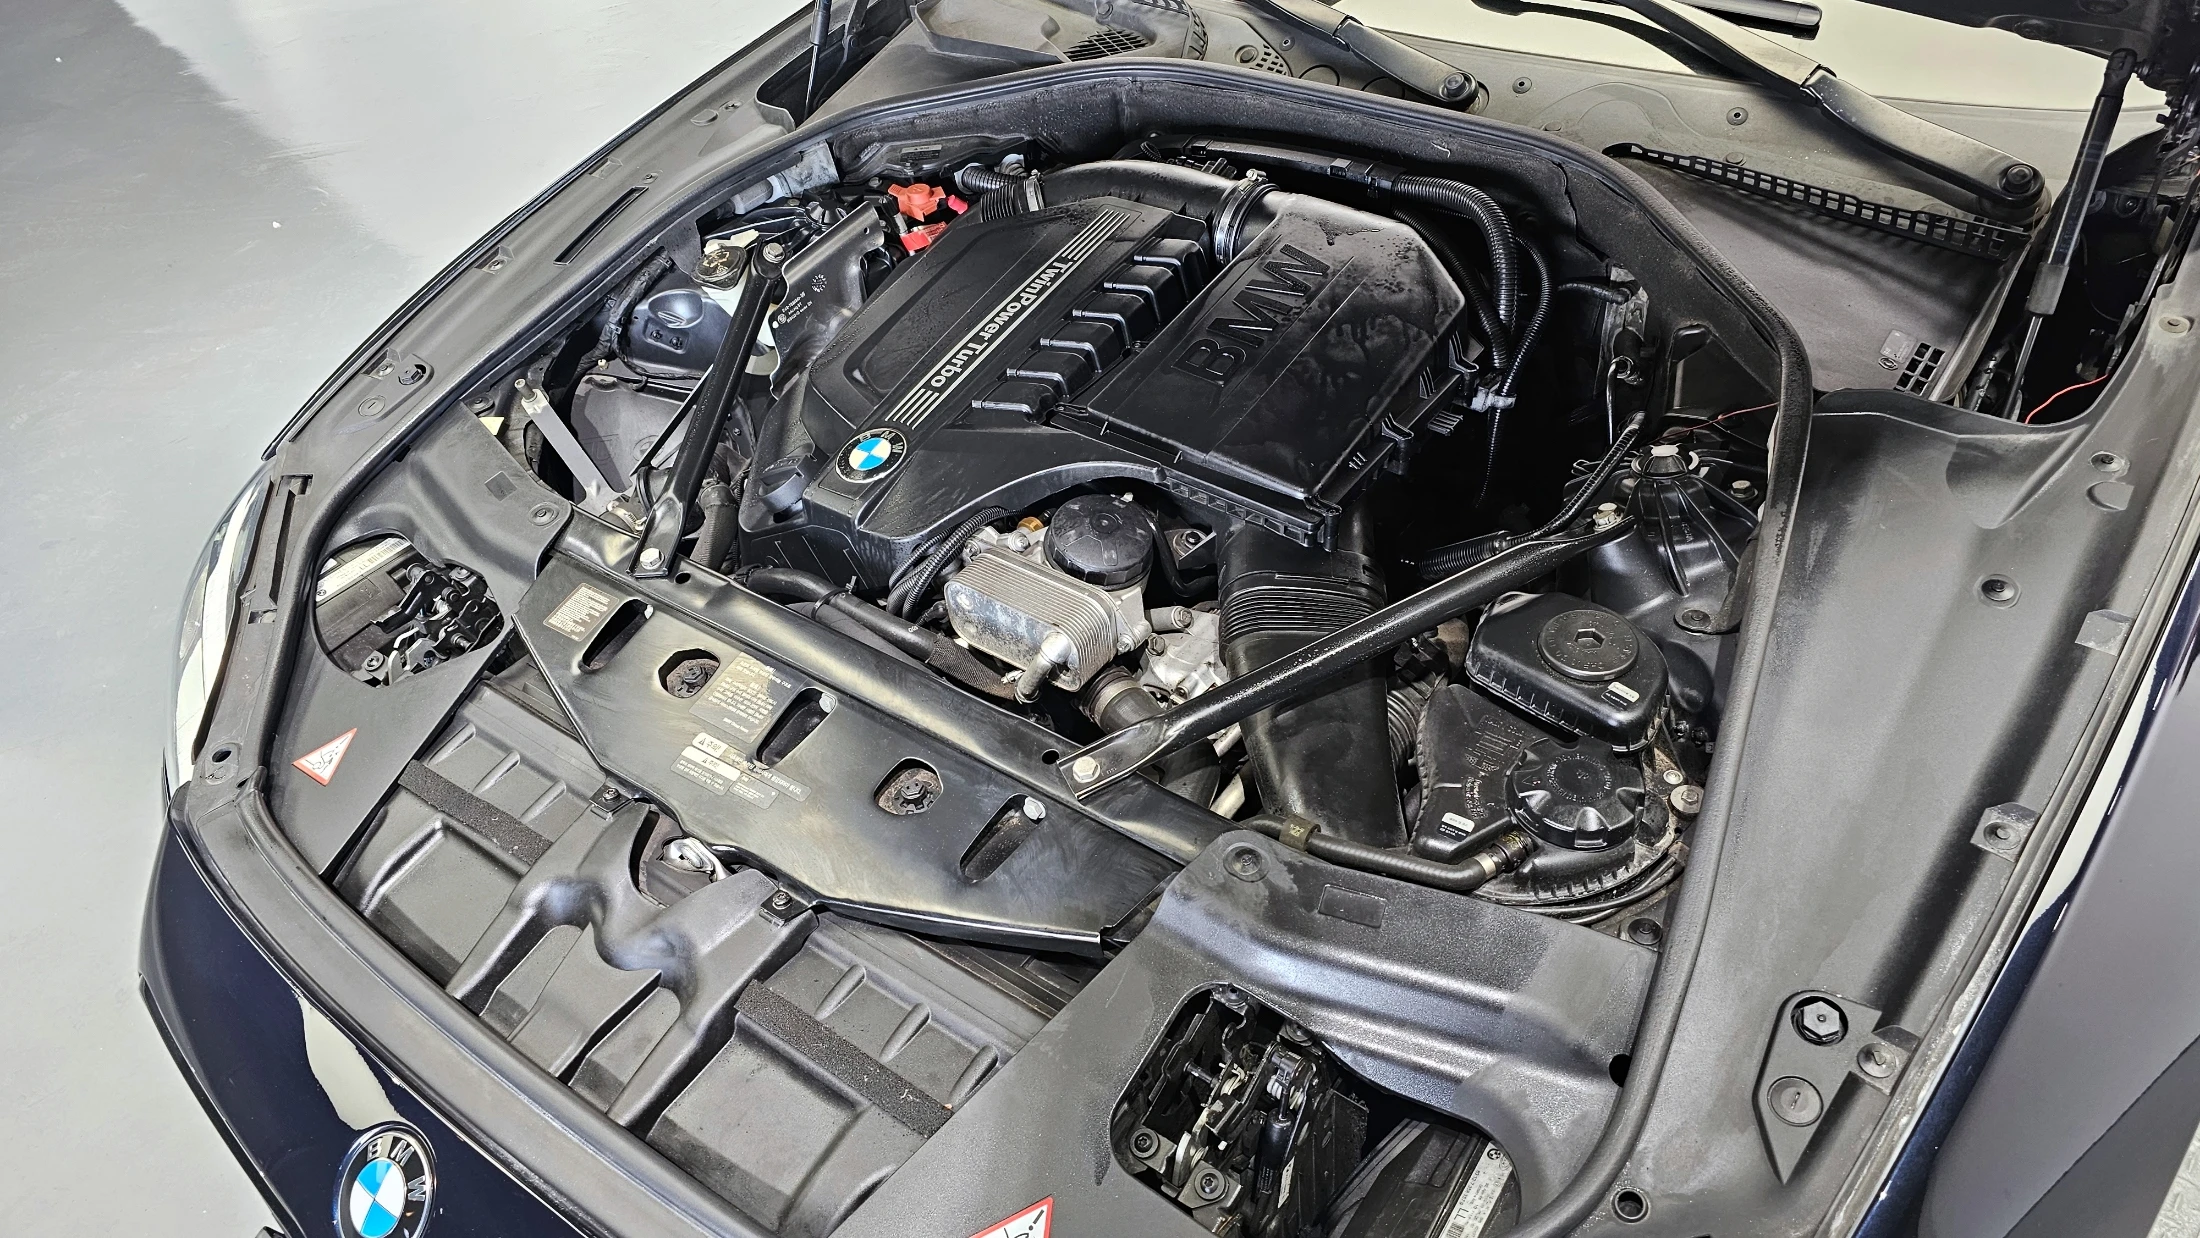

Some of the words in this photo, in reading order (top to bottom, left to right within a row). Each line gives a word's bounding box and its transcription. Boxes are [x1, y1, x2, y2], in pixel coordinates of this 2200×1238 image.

[979, 261, 1074, 341] TwinPower
[1171, 243, 1331, 387] BMW
[930, 341, 989, 388] Turbo
[860, 431, 904, 454] BMW
[366, 1137, 427, 1202] BMW
